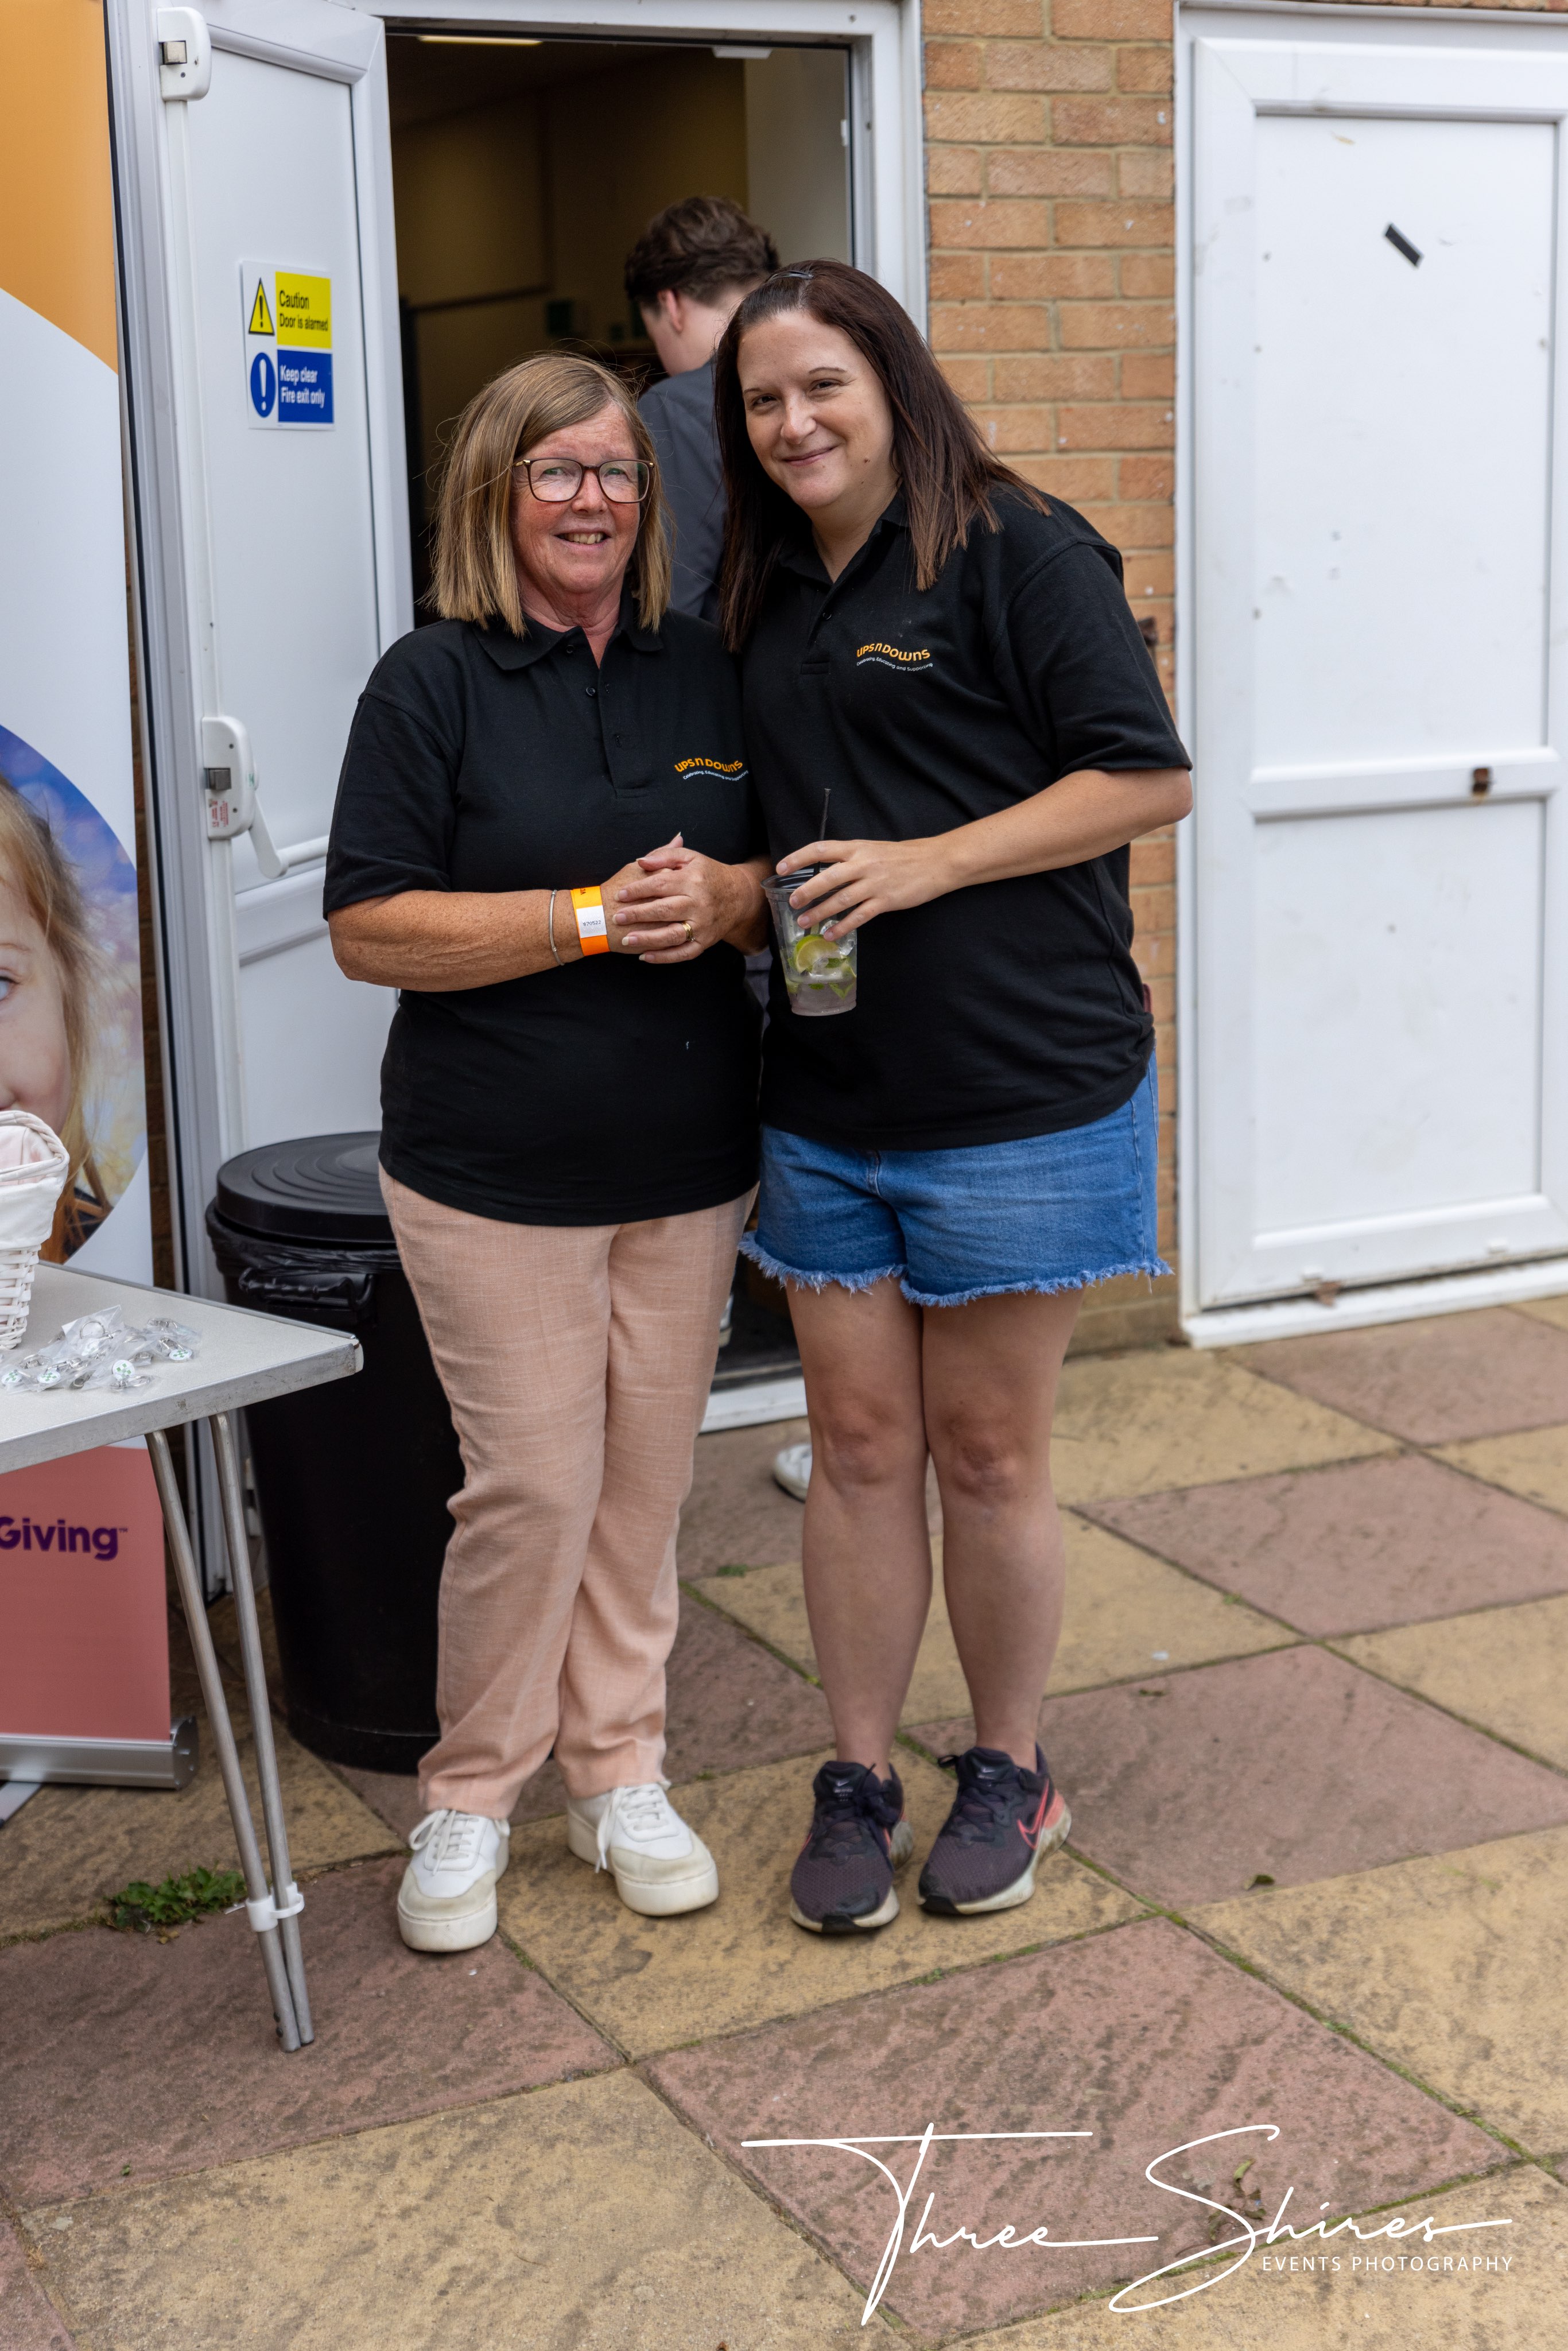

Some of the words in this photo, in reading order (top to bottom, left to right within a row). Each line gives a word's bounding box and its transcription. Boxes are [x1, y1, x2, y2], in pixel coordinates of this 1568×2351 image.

[280, 290, 309, 309] Caution
[280, 313, 296, 328] Door
[298, 316, 303, 329] is
[305, 317, 328, 332] alarmed
[280, 366, 299, 386] Keep
[301, 367, 317, 383] clear
[281, 387, 295, 404] Fire
[297, 389, 309, 404] exit
[311, 389, 325, 409] only
[876, 657, 895, 669] Educating
[907, 663, 933, 672] Supporting
